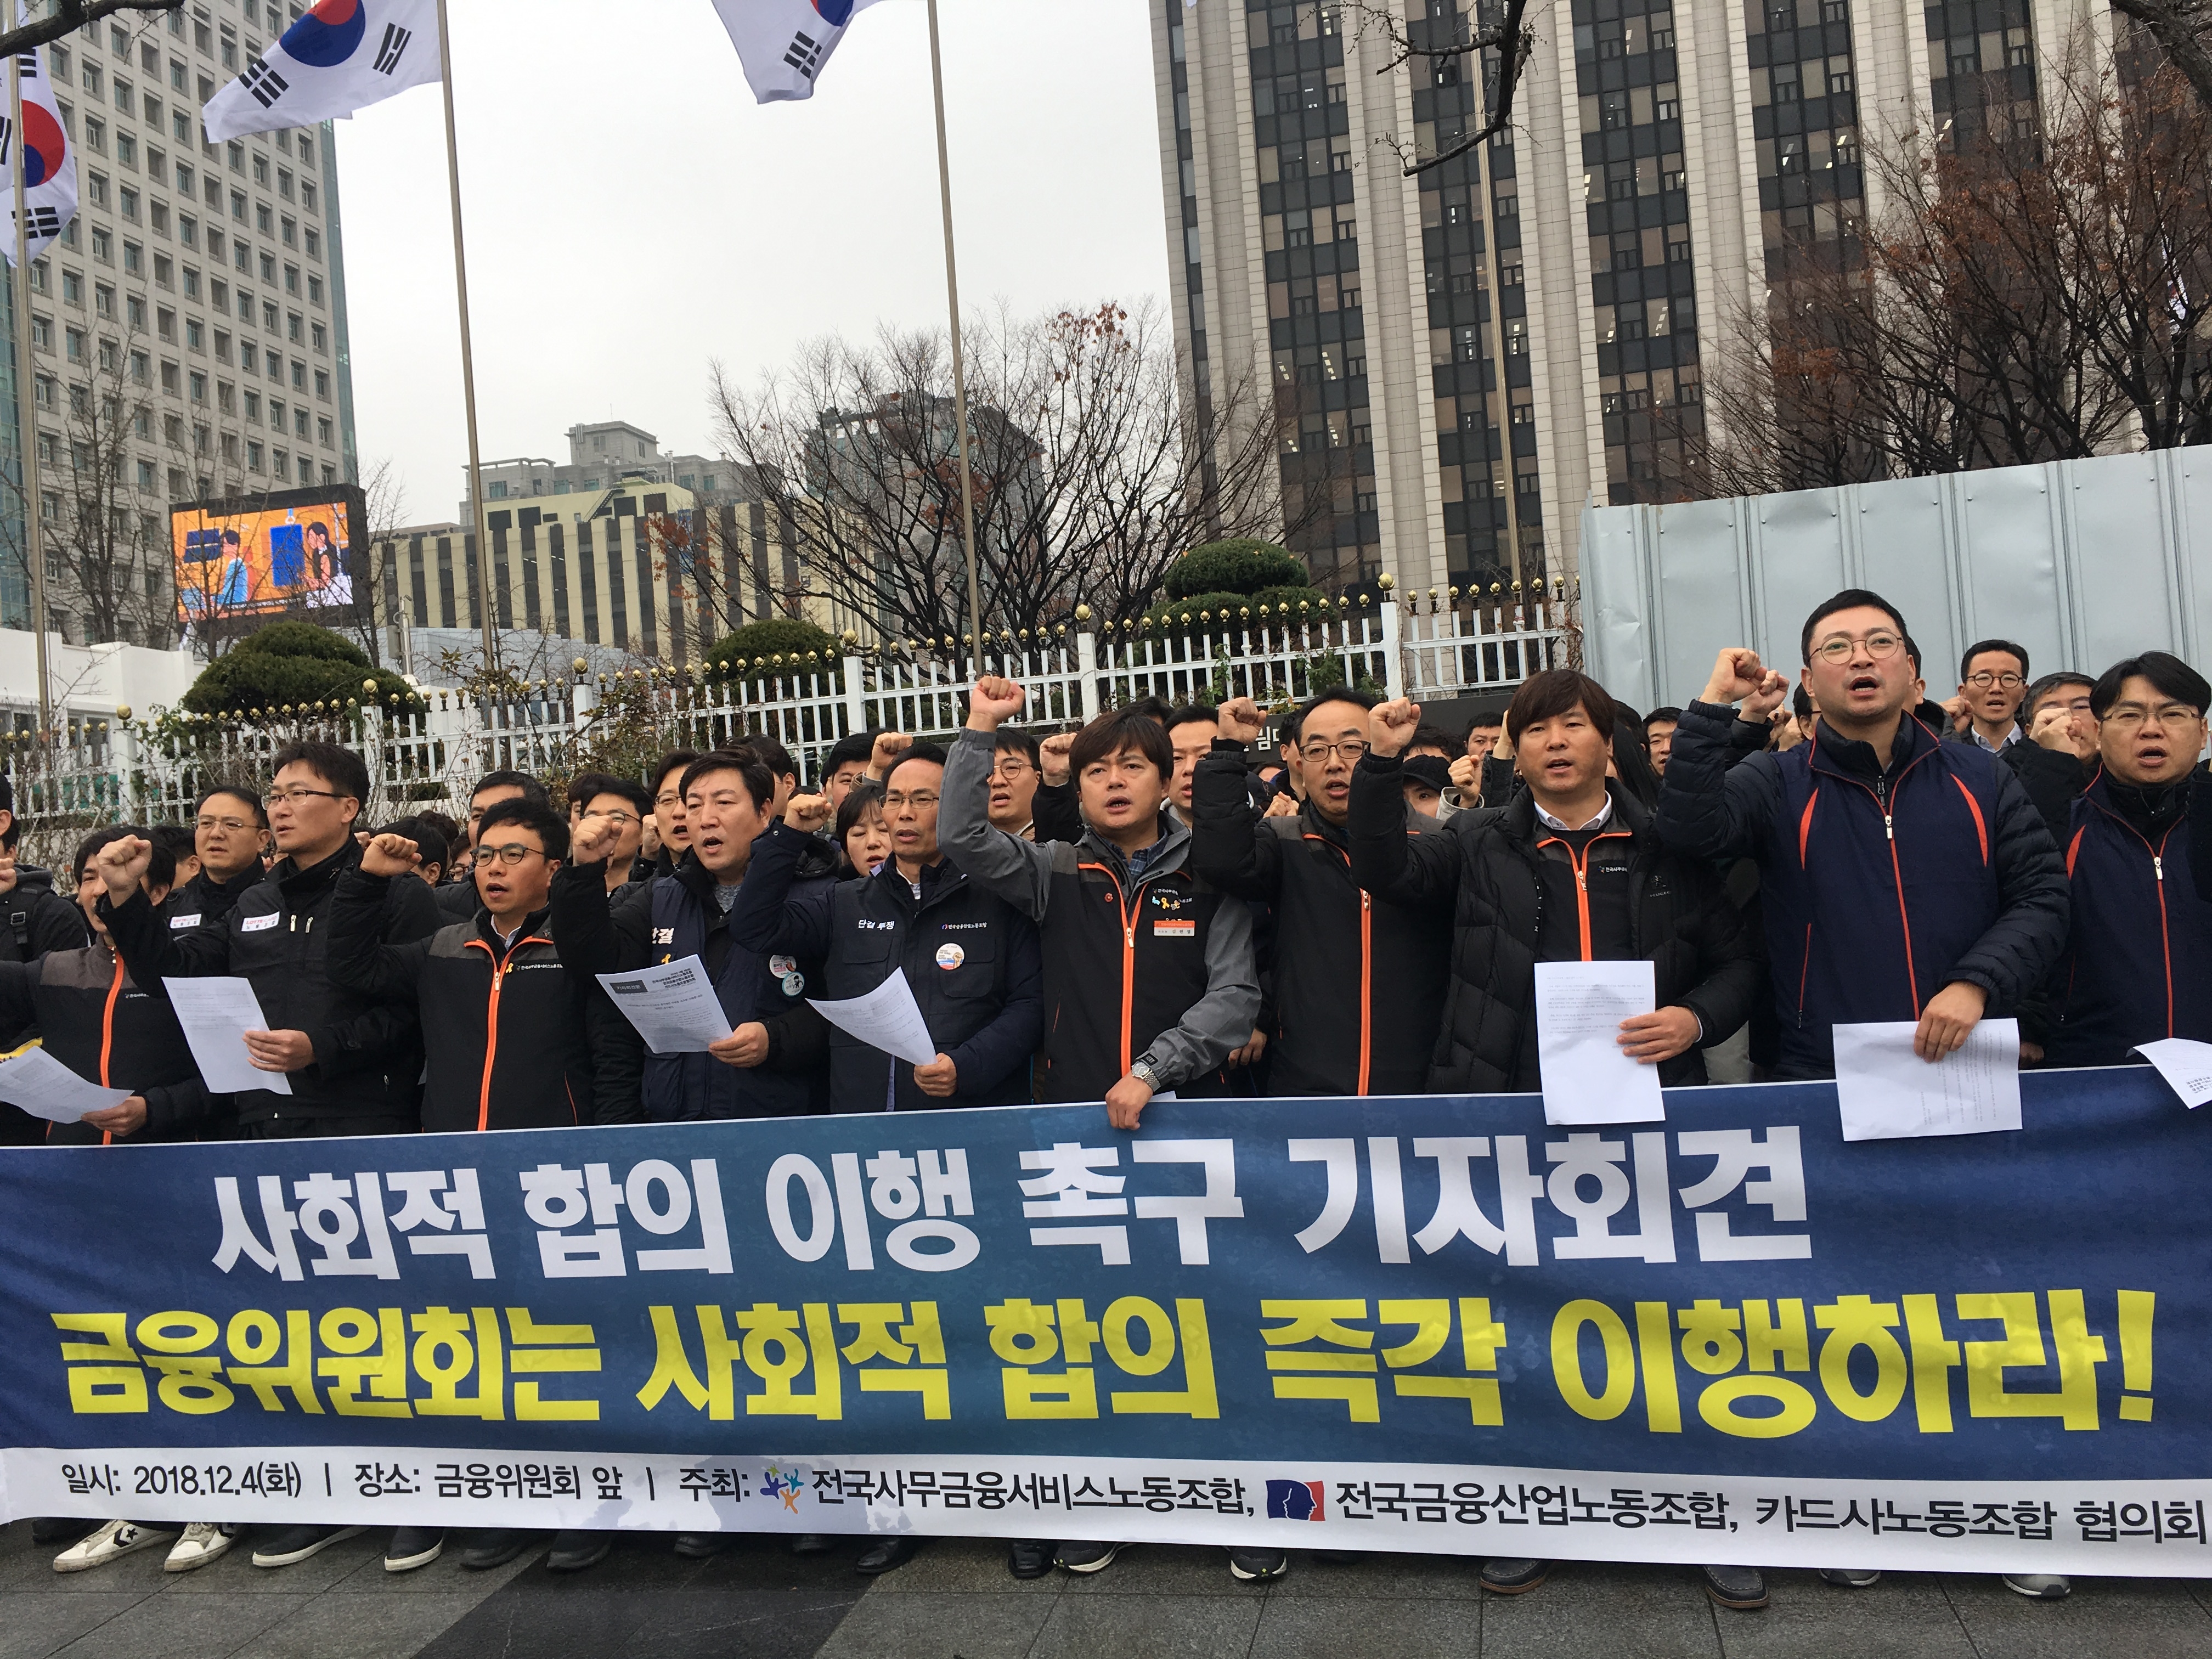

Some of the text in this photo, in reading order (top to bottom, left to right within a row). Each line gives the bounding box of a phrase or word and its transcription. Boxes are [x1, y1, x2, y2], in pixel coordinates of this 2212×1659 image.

[858, 919, 895, 930] 단결 투쟁
[212, 1126, 1813, 1282] 사회적 합의 이행 촉구 기자회견
[52, 1289, 2155, 1438] 금융위원회는 사회적 합의 즉각 이행하라!
[61, 1462, 2208, 1545] 일시: 2018.12.4(화) 장소: 금융위원회 앞 주최: 전국사무금융서비스노동조합, 전국금융산업노동조합, 카드사노동조합 협의회
